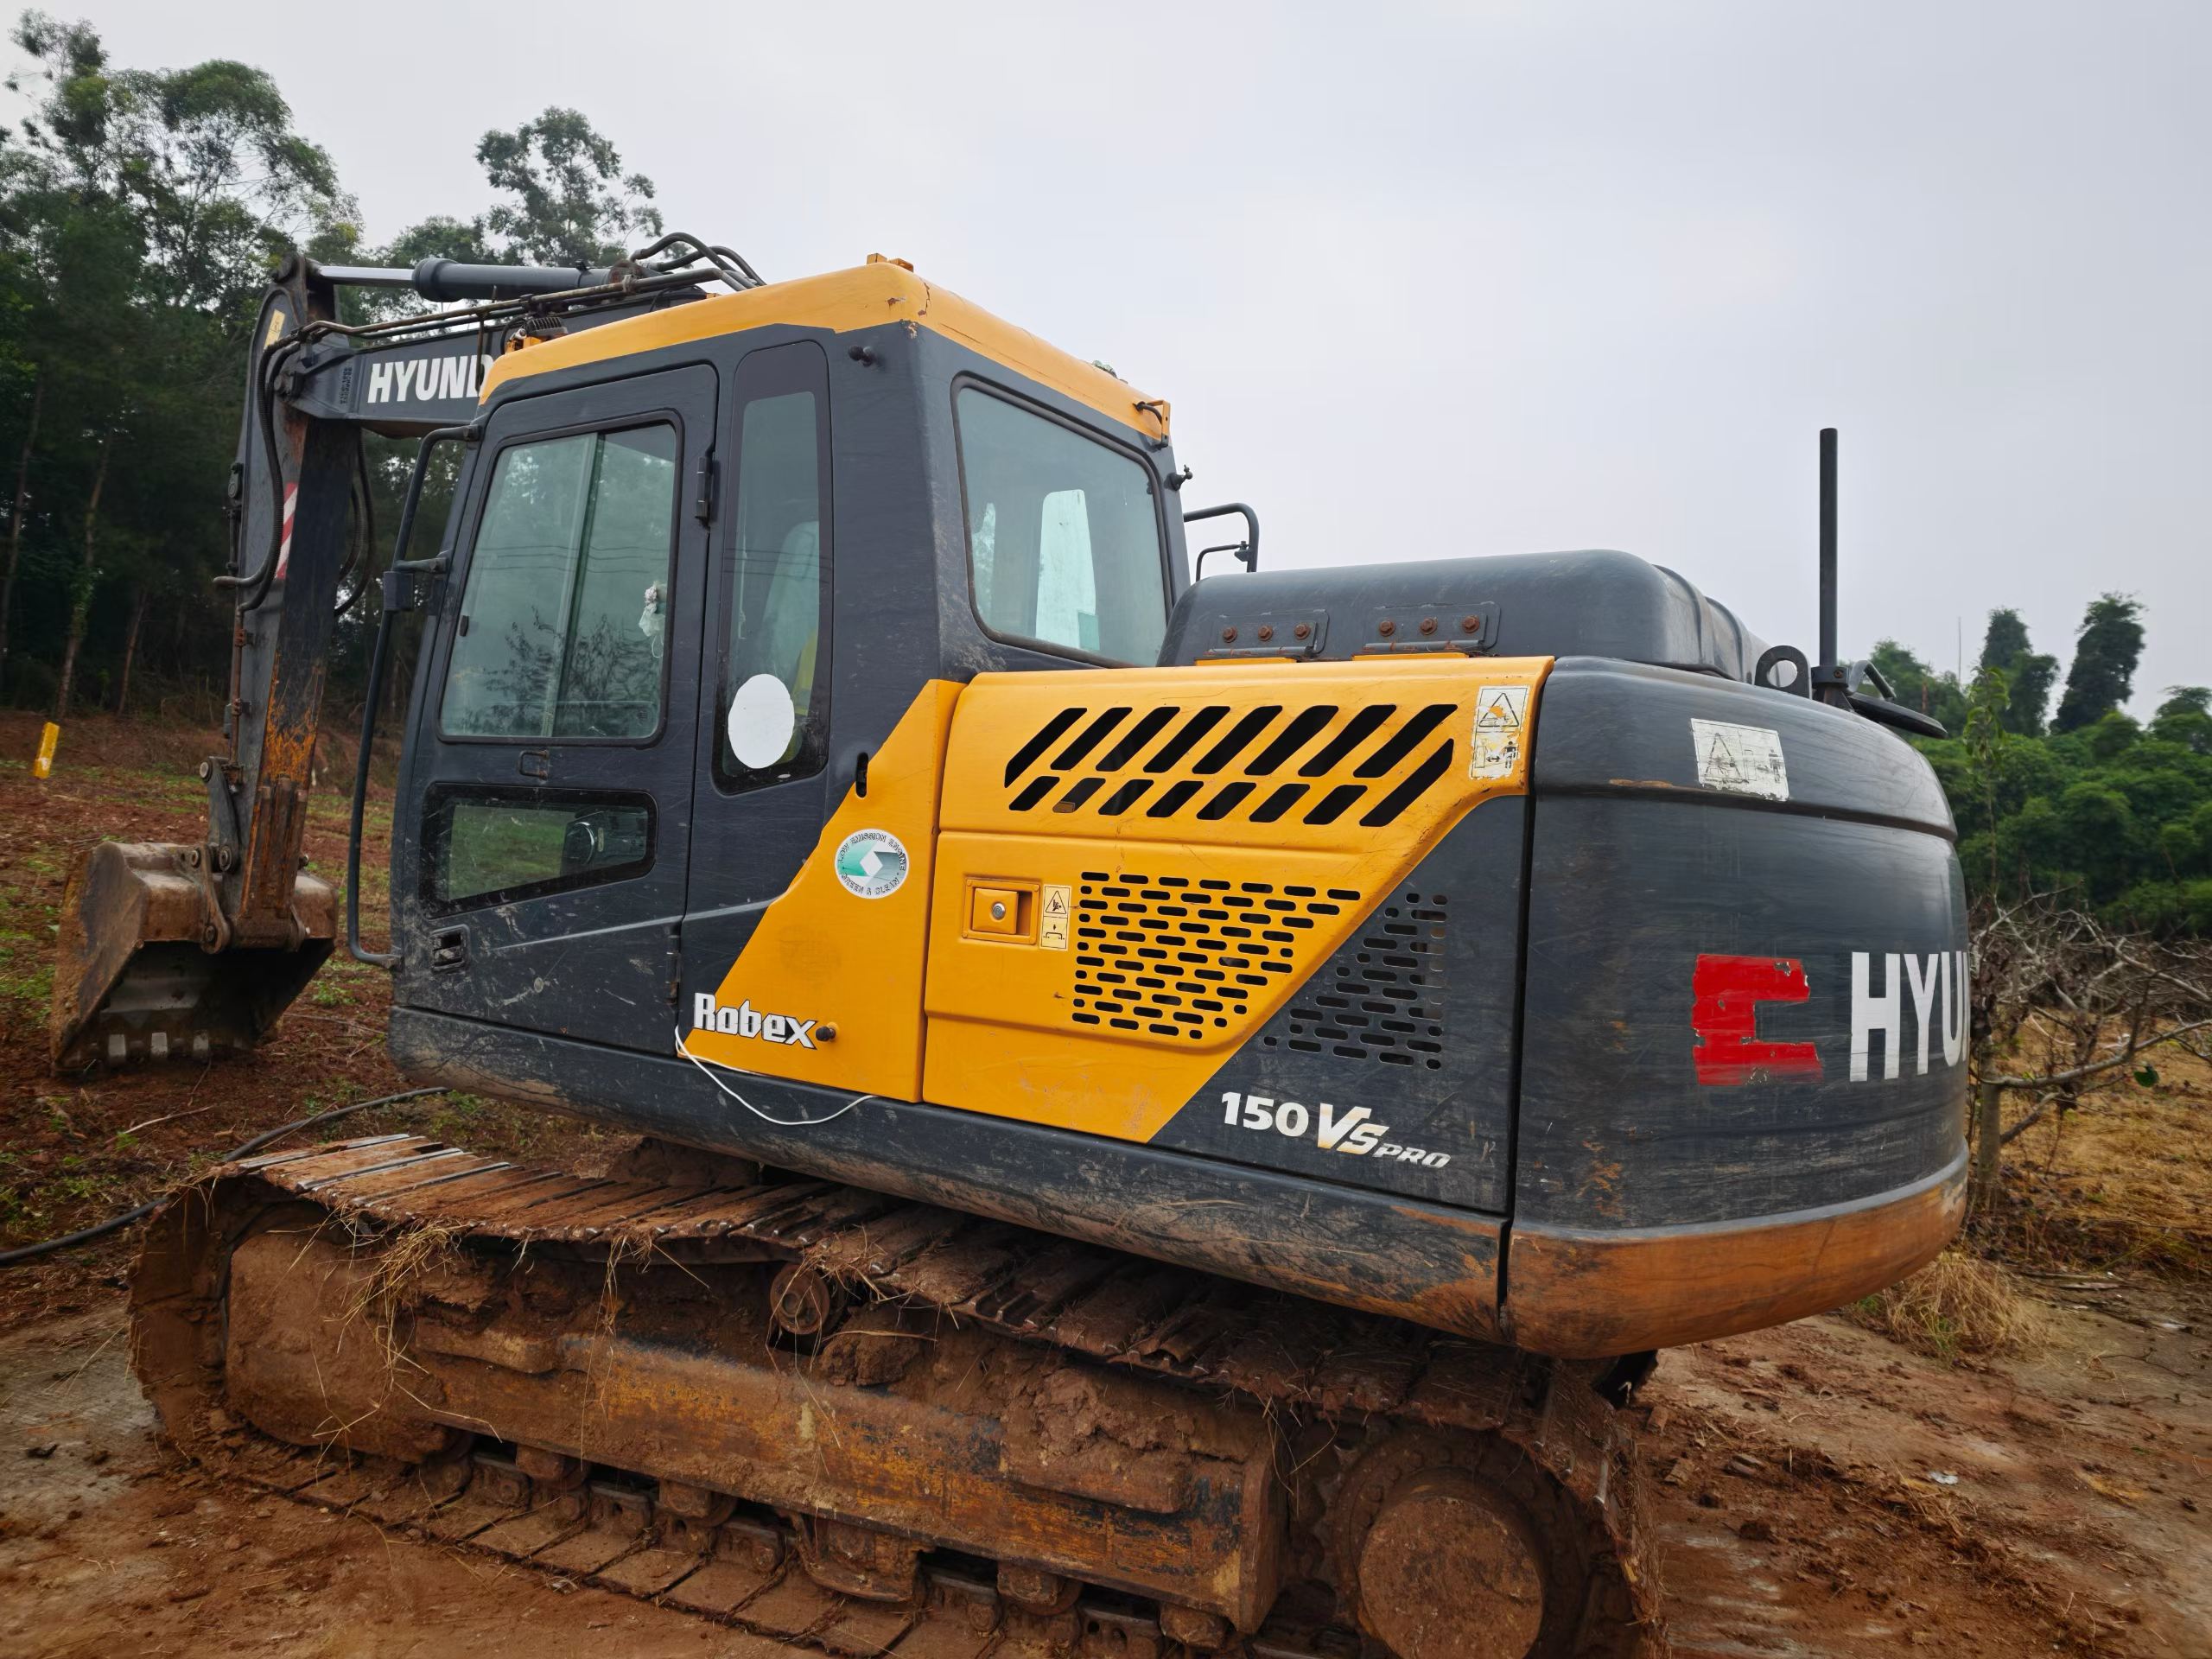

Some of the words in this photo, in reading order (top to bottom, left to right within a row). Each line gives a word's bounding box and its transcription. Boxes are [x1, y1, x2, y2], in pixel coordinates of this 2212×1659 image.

[838, 842, 849, 863] LOW
[850, 832, 887, 844] EMISSION
[888, 839, 906, 871] ENGINE
[842, 873, 864, 893] GREEN
[875, 877, 899, 895] CLEAN
[693, 992, 817, 1050] Robex
[1372, 1142, 1452, 1169] PRO
